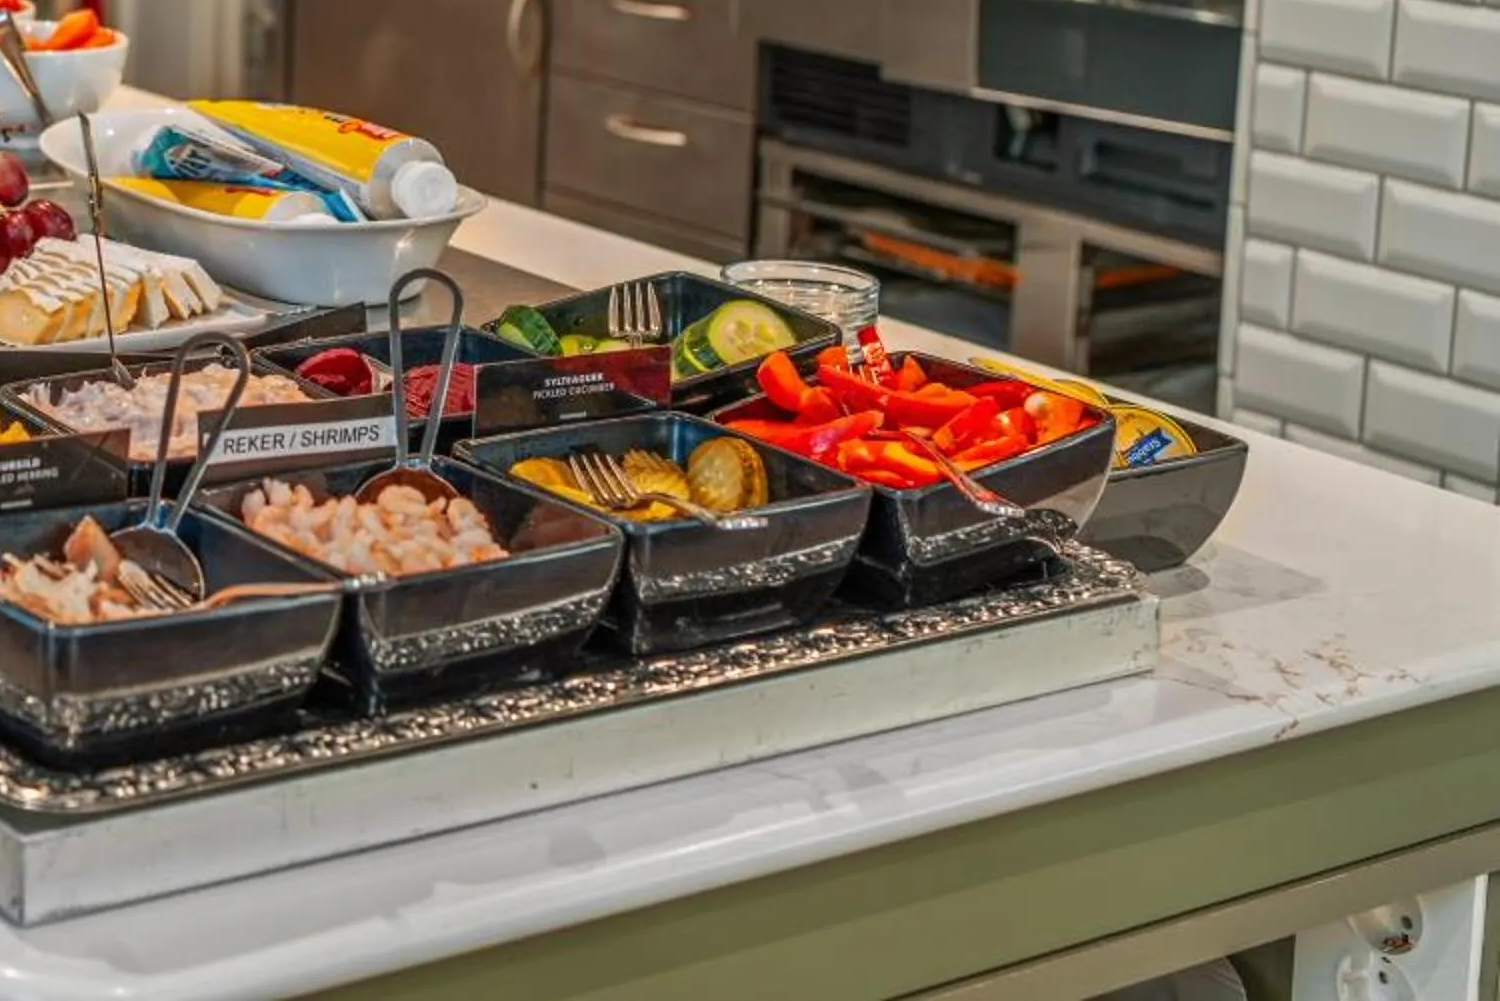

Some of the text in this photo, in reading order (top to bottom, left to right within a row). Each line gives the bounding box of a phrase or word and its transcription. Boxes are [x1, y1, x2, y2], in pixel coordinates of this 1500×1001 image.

[534, 388, 566, 399] PICKLED
[223, 432, 285, 455] REKER
[301, 424, 381, 448] SHRIMPS
[17, 467, 59, 482] HERRING
